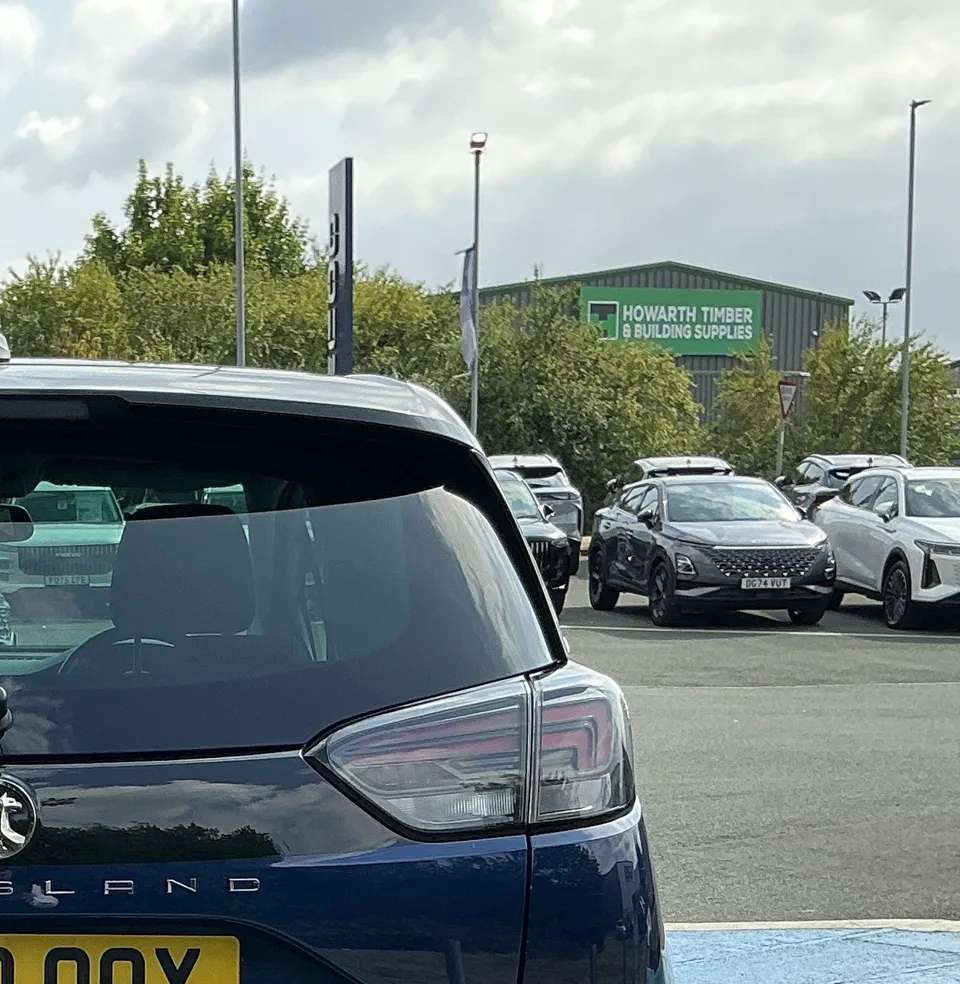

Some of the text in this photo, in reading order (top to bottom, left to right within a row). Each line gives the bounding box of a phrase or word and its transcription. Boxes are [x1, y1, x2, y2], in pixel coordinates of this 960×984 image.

[622, 305, 753, 323] HOWARTH TIMBER
[622, 323, 753, 340] & BUILDING SUPPLIES
